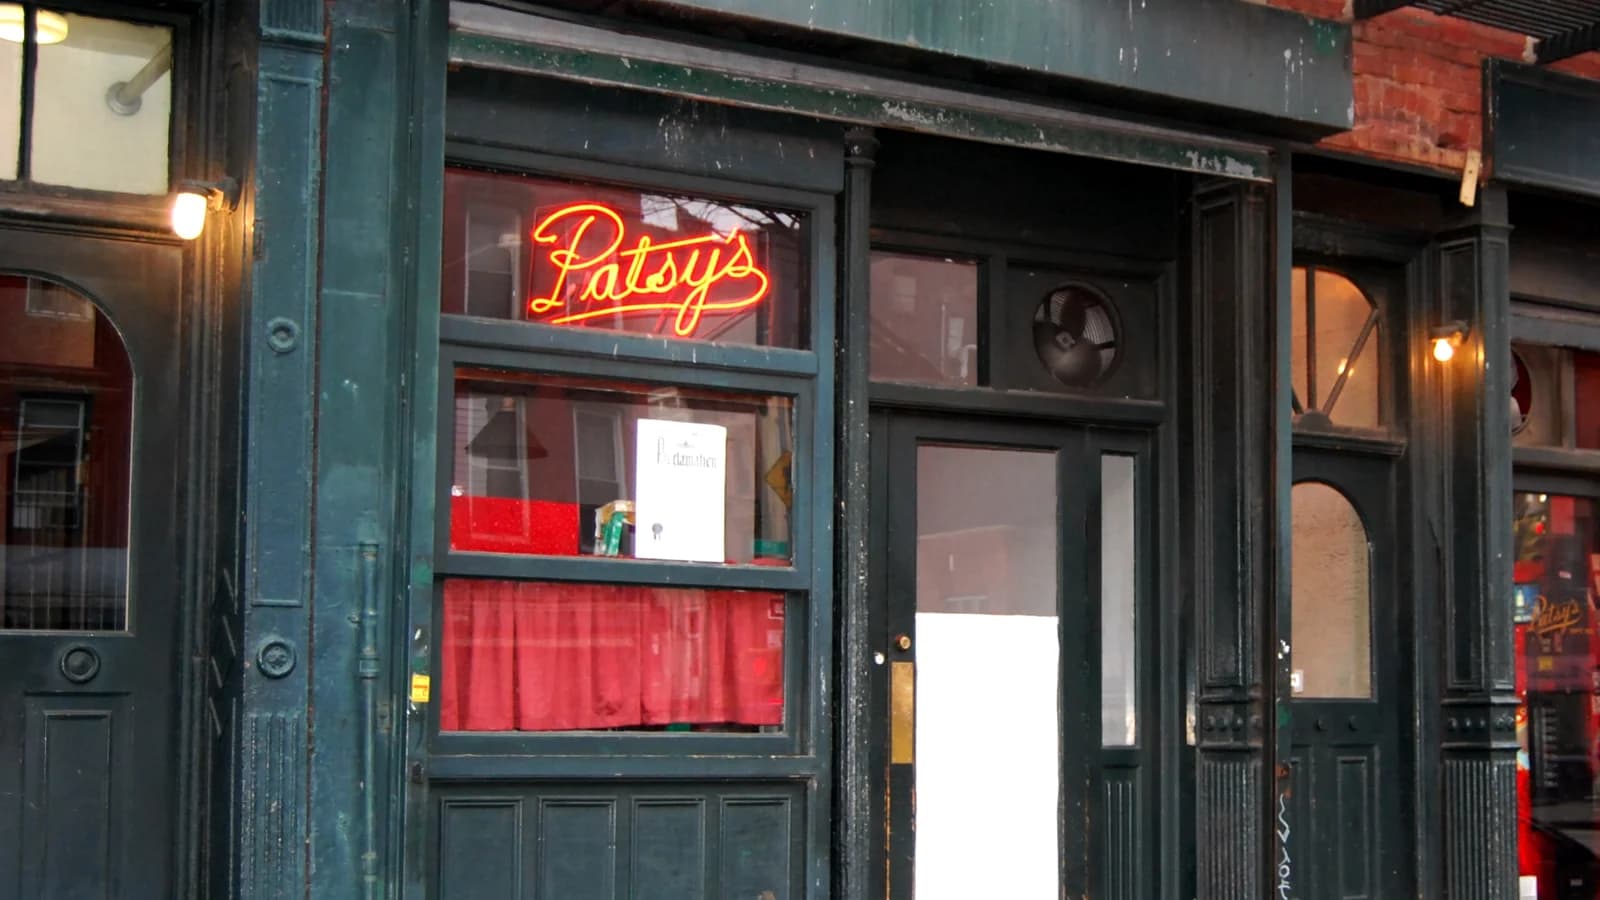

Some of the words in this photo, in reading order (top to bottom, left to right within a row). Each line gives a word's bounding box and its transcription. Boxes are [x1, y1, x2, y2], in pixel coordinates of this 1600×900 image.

[531, 204, 767, 336] Patsy's
[657, 436, 717, 468] Pclamation
[1527, 595, 1583, 634] Patsy's
